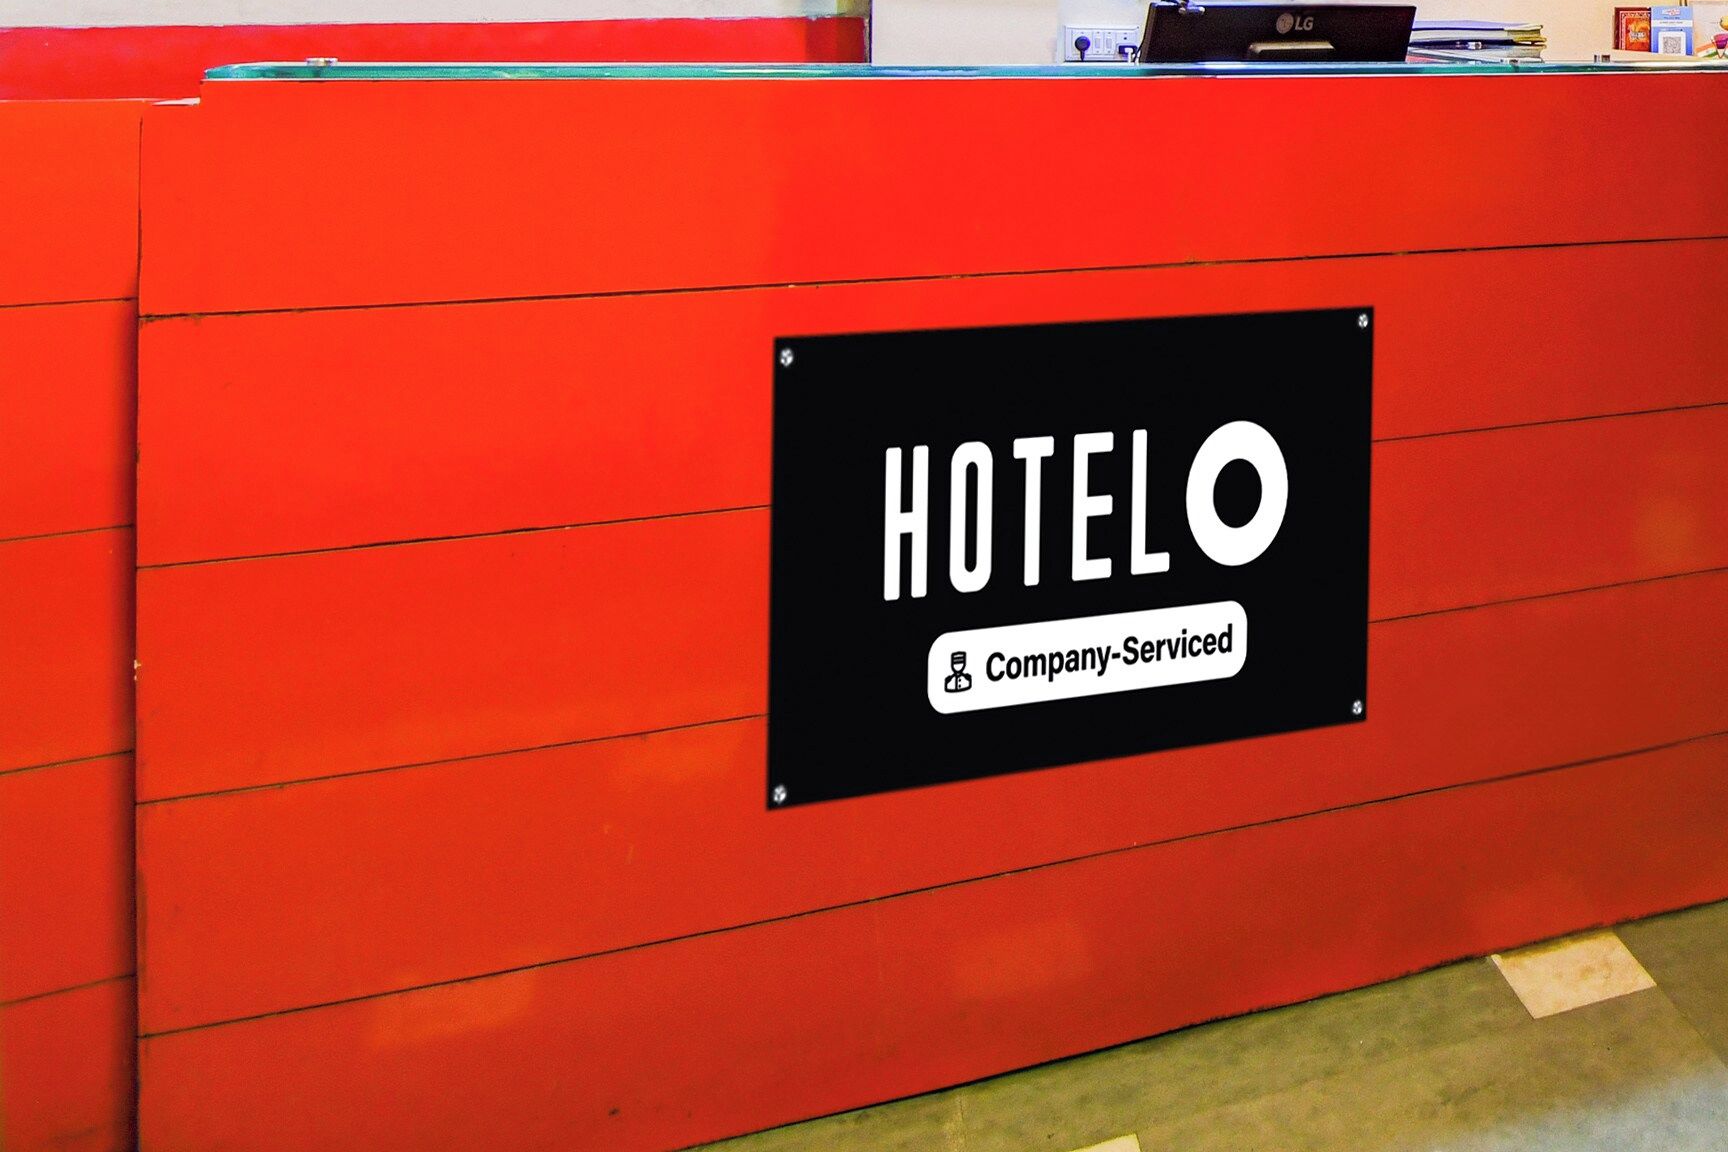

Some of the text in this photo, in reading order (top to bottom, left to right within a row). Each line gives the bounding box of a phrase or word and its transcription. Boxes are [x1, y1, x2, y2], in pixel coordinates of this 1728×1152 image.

[1294, 15, 1314, 31] LG
[883, 428, 1170, 601] HOTEL
[985, 623, 1233, 682] Company-Serviced
